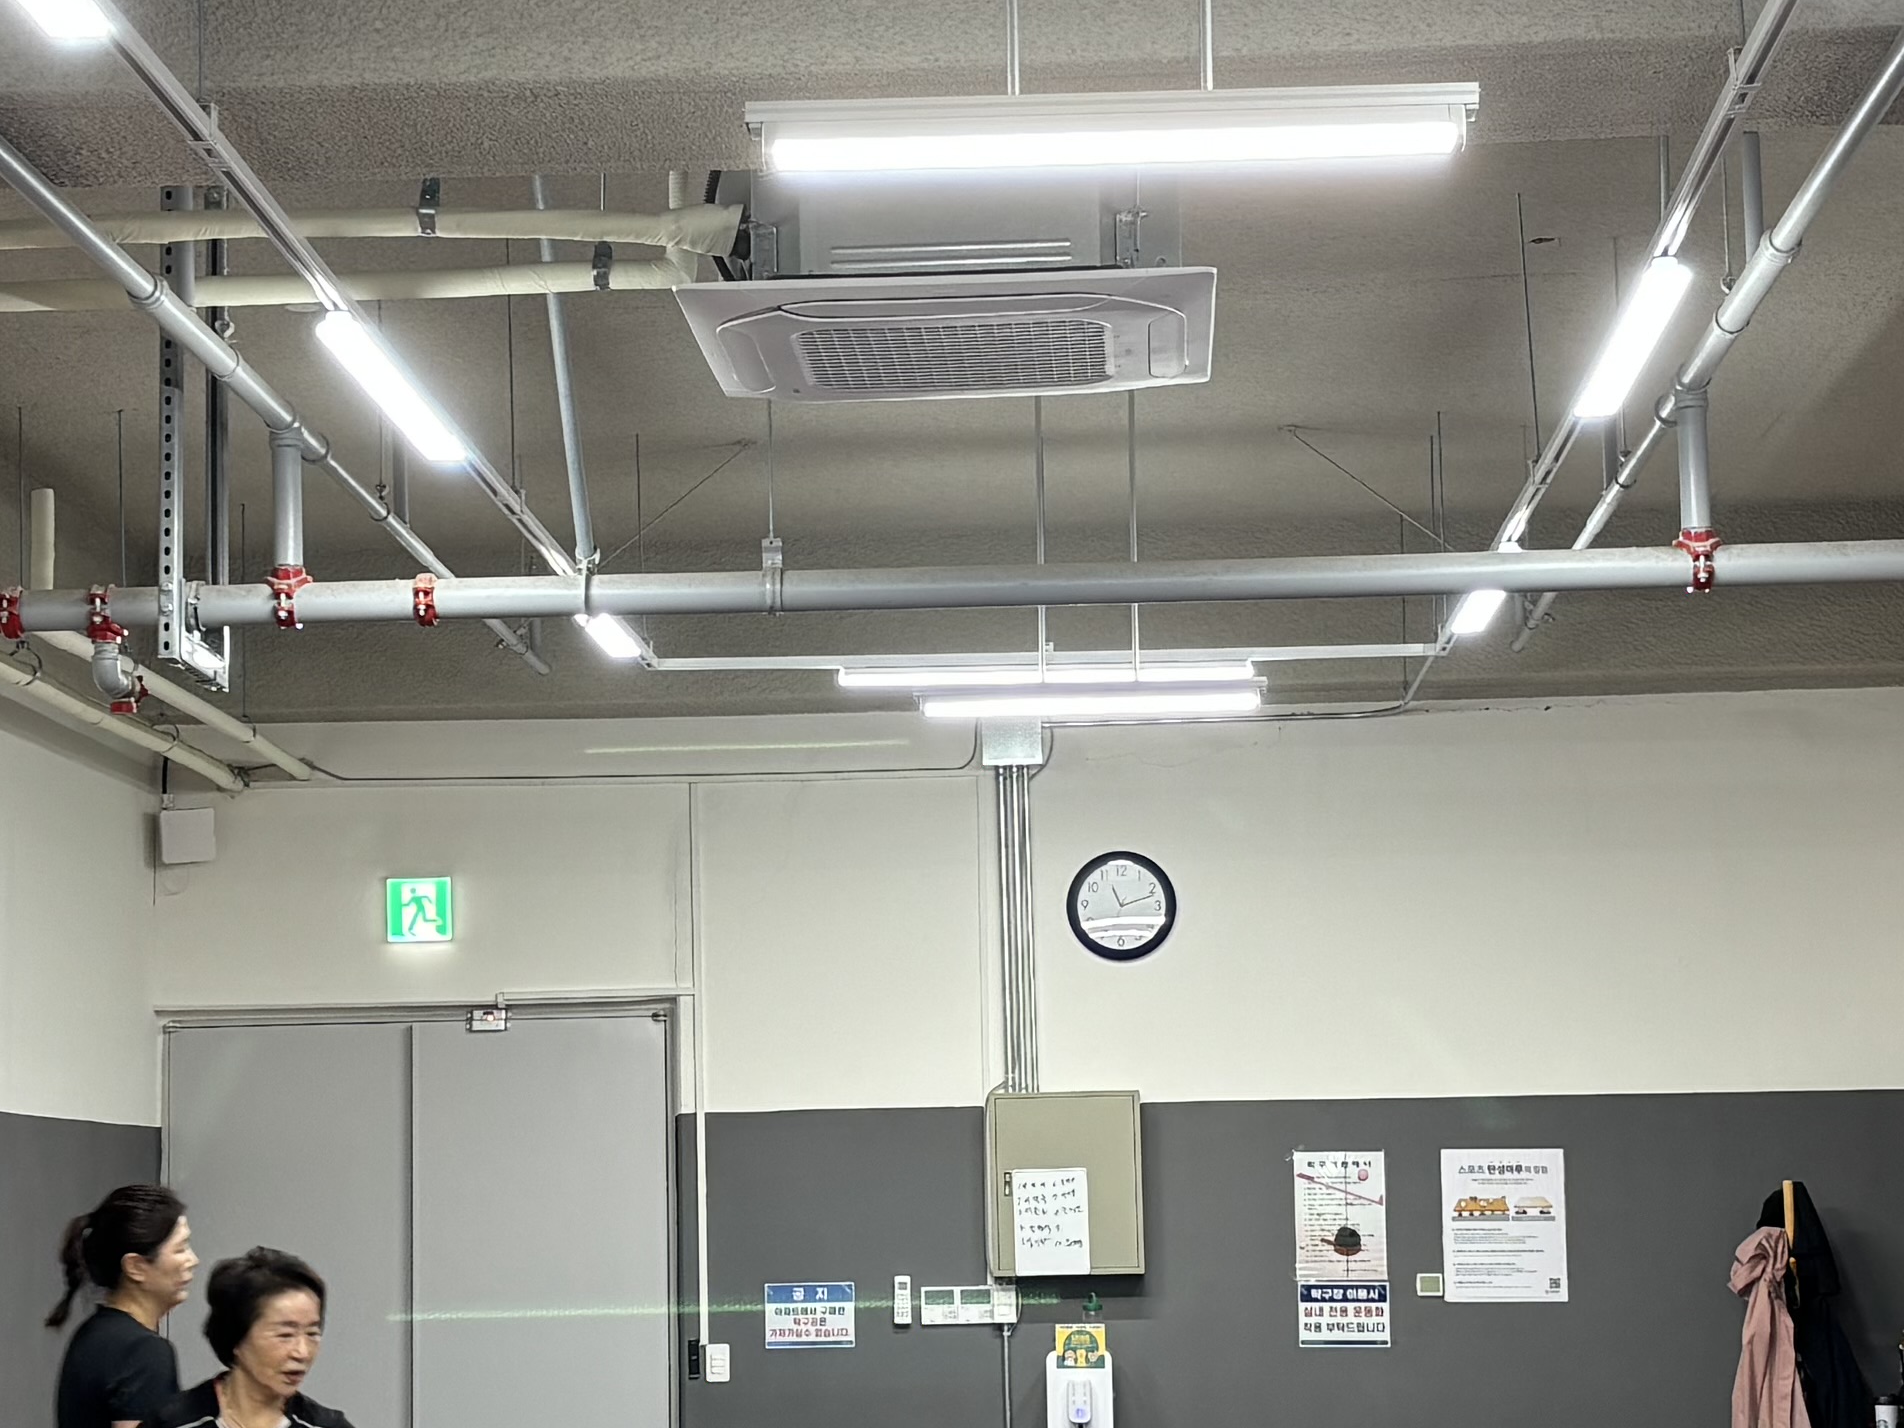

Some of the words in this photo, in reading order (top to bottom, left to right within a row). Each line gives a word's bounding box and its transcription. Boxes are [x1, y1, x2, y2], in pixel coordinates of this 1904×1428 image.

[1100, 869, 1109, 881] 11
[1116, 865, 1127, 876] 12
[1137, 870, 1142, 882] 1
[1087, 882, 1099, 893] 10
[1148, 882, 1156, 894] 2
[1081, 899, 1089, 911] 9
[1154, 900, 1162, 911] 3
[1117, 935, 1125, 947] 6
